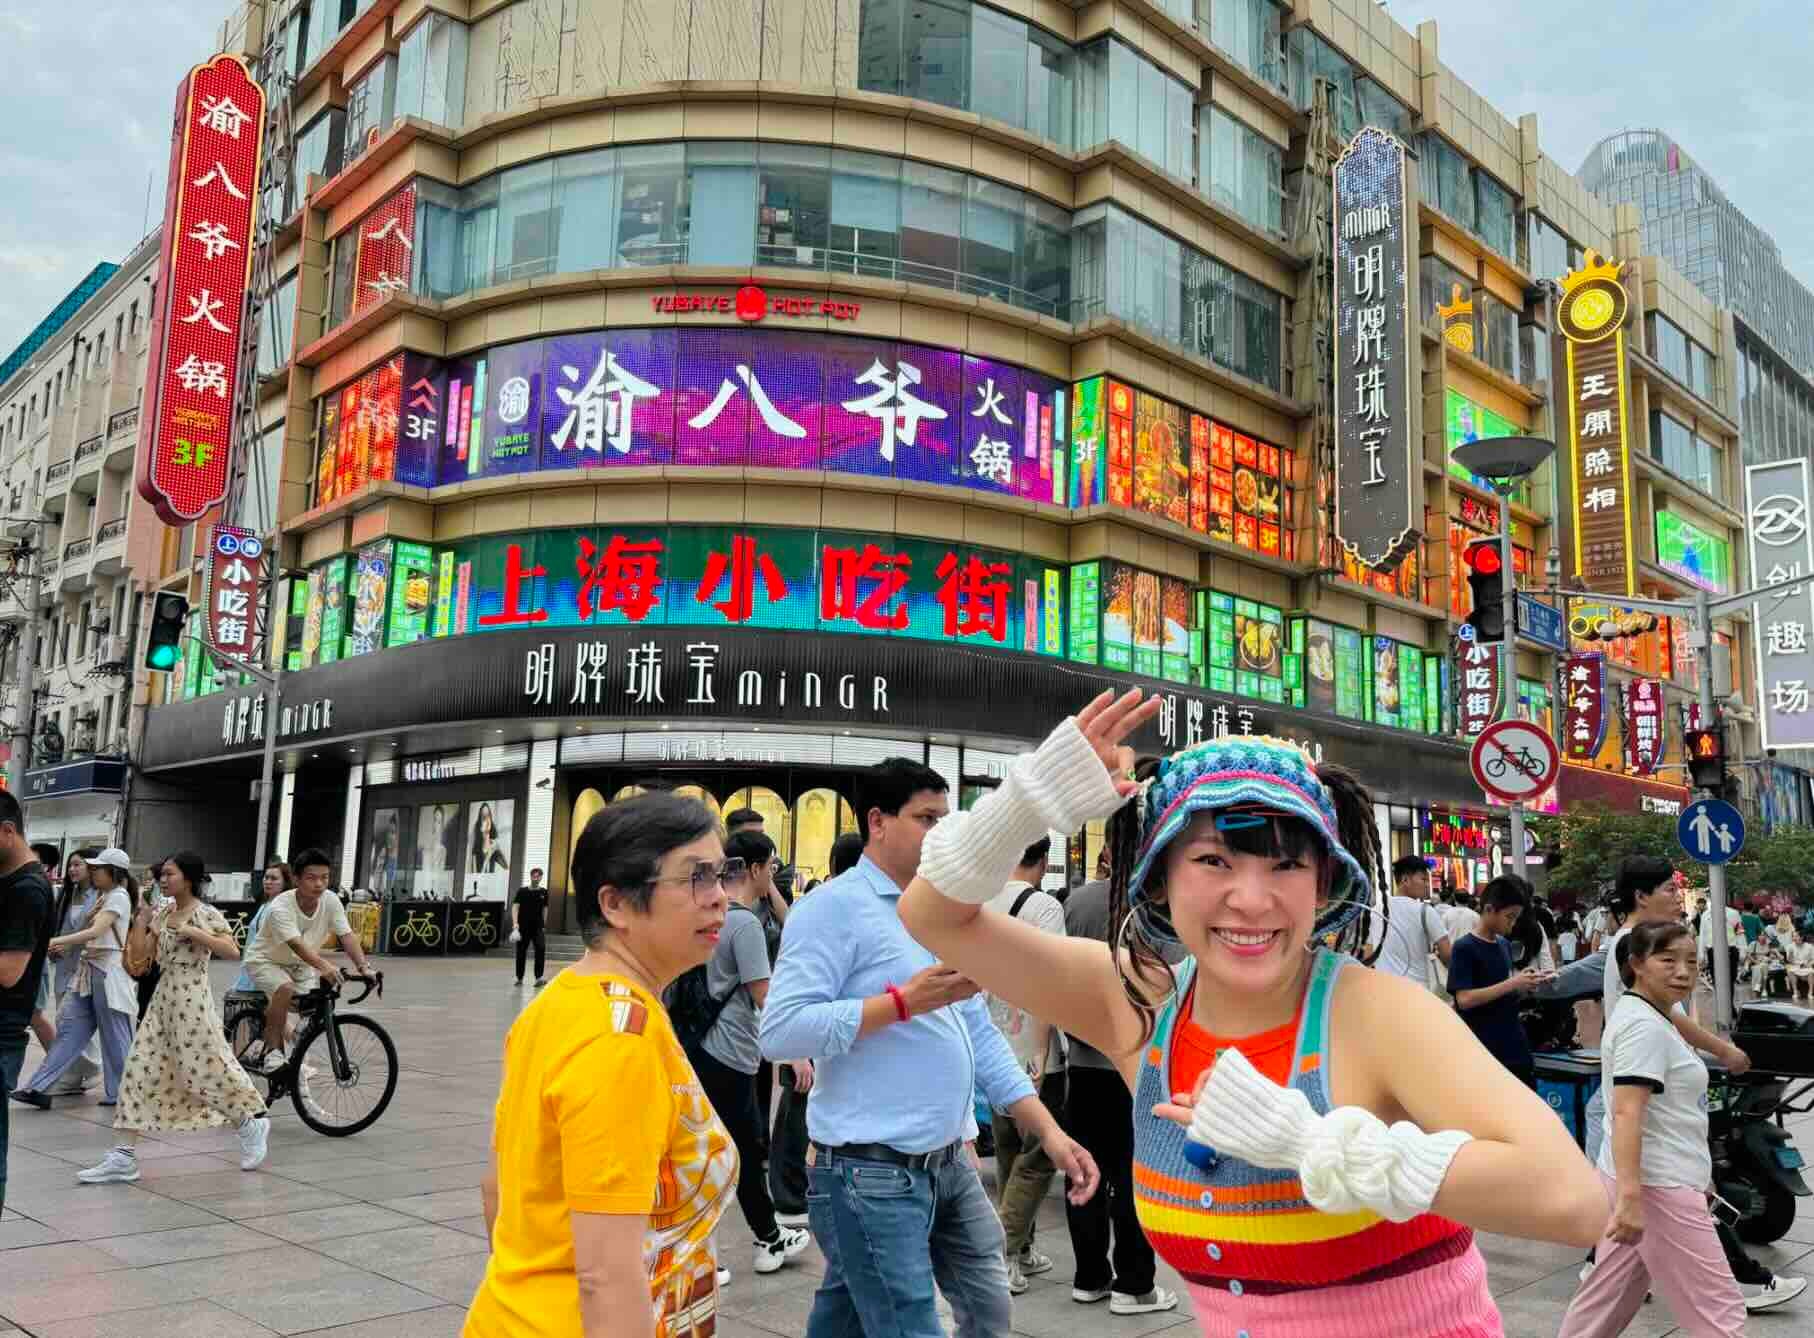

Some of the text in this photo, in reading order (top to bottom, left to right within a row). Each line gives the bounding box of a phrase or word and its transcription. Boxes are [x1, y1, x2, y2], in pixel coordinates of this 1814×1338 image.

[173, 94, 250, 397] 渝八爷火锅
[652, 296, 729, 314] YUBAYE
[772, 298, 814, 315] HOT
[1353, 244, 1390, 486] 明牌珠宝
[405, 414, 437, 441] 3F
[550, 350, 949, 463] 渝八爷
[970, 378, 1014, 485] 火锅
[172, 438, 214, 469] 3F
[217, 558, 253, 646] 小吃街
[478, 535, 1014, 643] 上海小吃街
[525, 640, 721, 706] 明牌珠宝
[1764, 560, 1811, 713] 创趣场
[222, 690, 266, 747] 明牌珠
[1465, 645, 1492, 716] 小吃街
[1468, 720, 1486, 733] 2F
